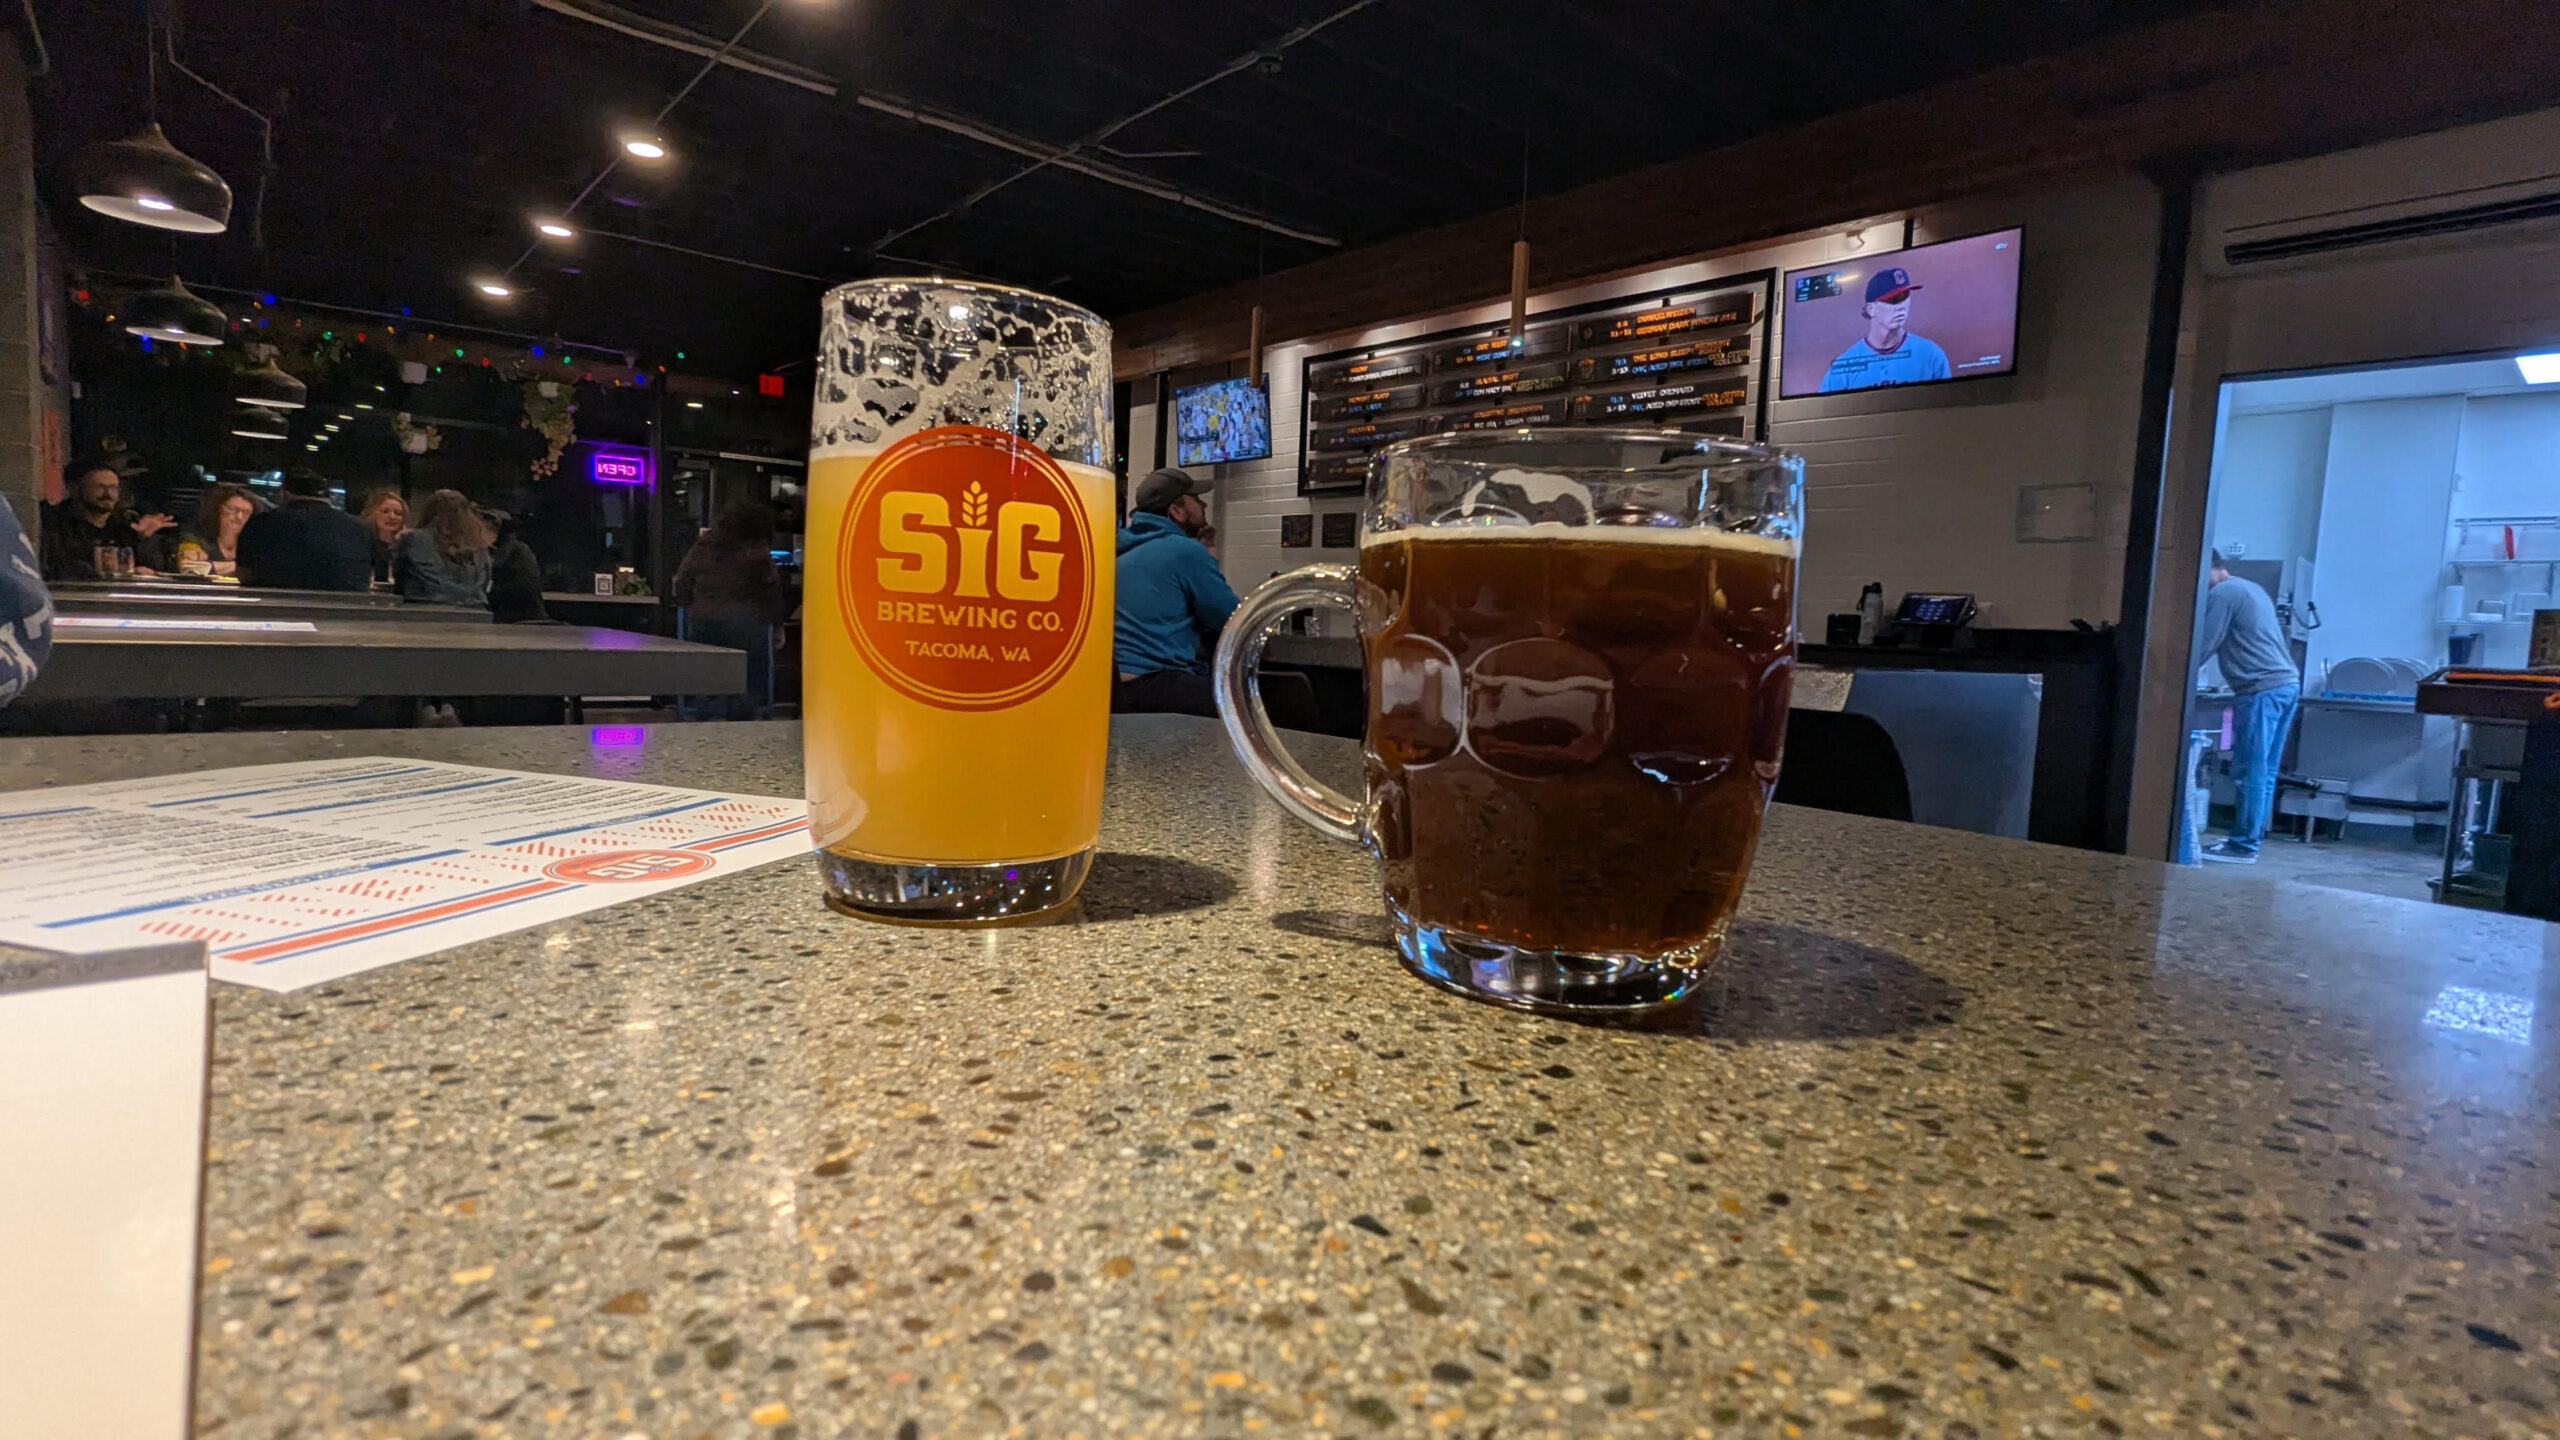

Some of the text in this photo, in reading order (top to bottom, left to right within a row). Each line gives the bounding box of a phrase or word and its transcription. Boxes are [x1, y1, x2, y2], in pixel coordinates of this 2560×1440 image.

[877, 600, 1064, 632] BREWING CO.
[905, 640, 1031, 663] TACOMA, WA
